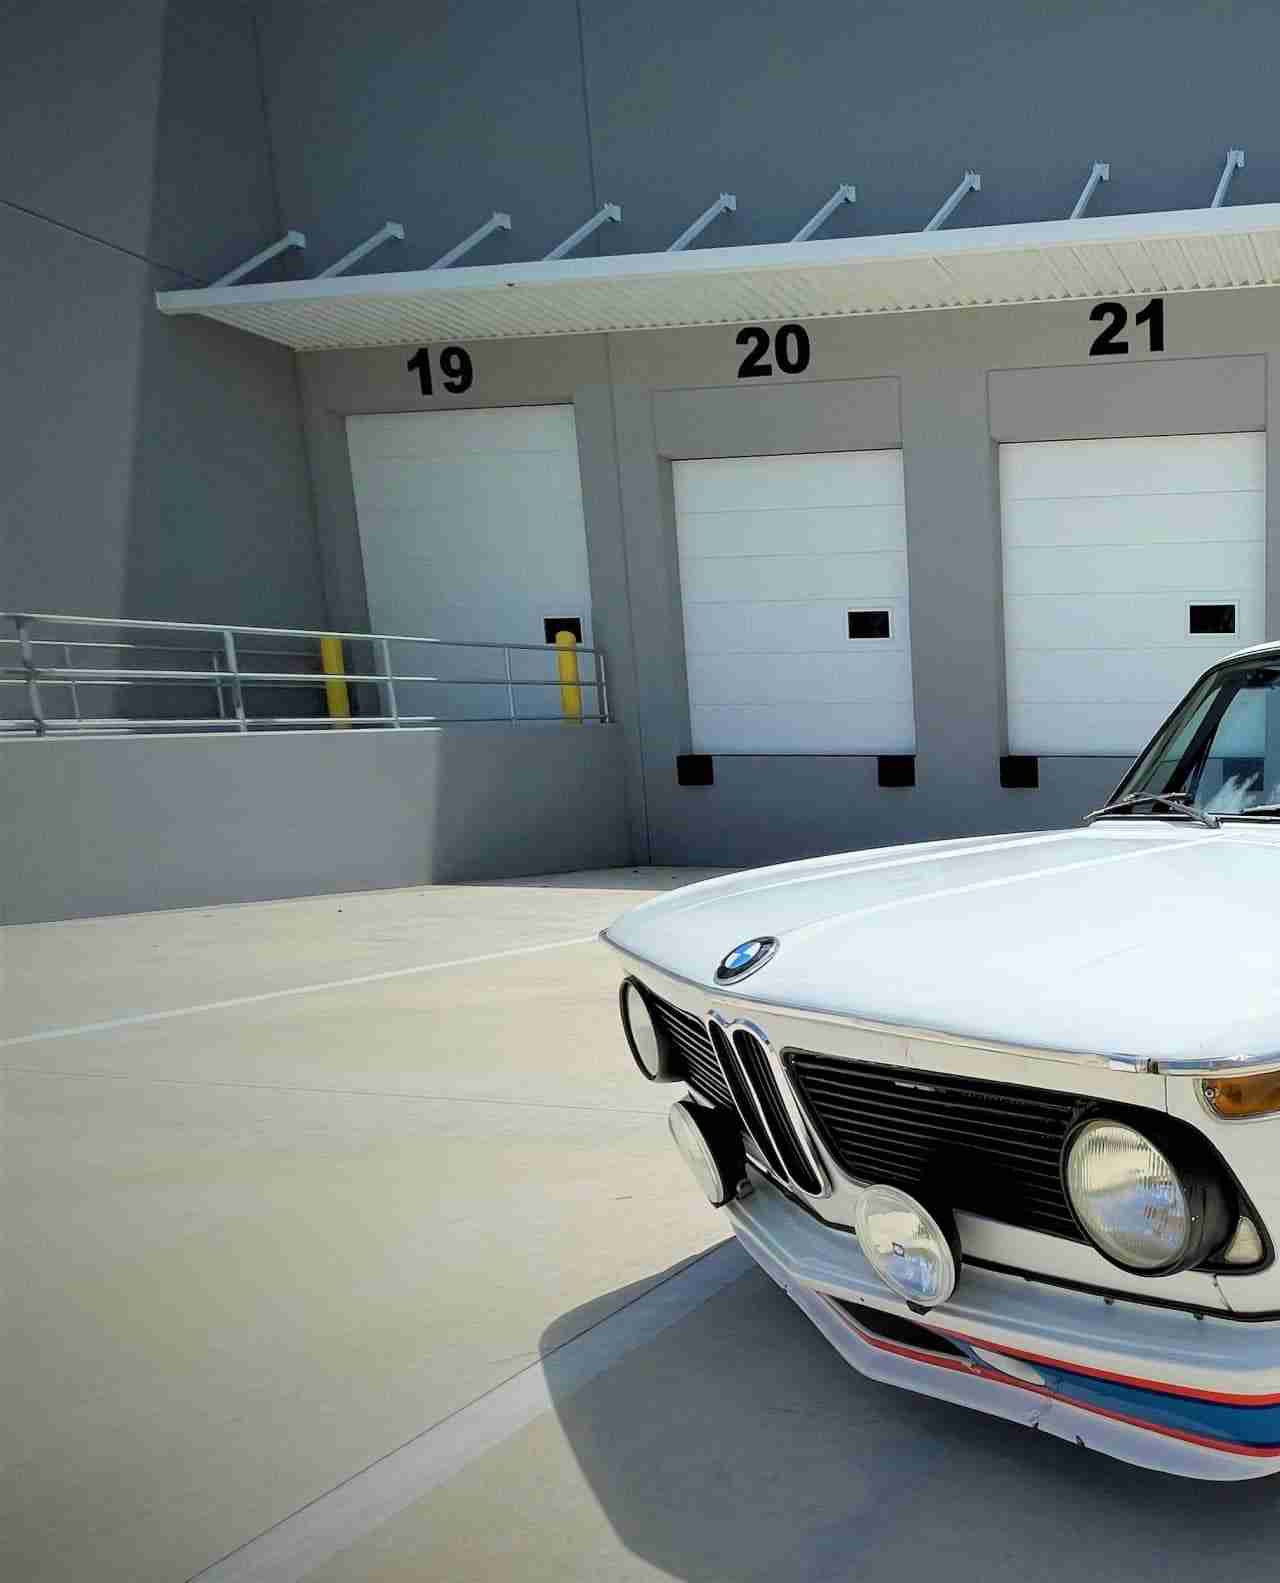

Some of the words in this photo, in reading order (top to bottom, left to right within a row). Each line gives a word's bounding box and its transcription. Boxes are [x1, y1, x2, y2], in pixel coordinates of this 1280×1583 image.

[736, 324, 810, 378] 20
[1089, 299, 1164, 356] 21
[407, 346, 473, 396] 19
